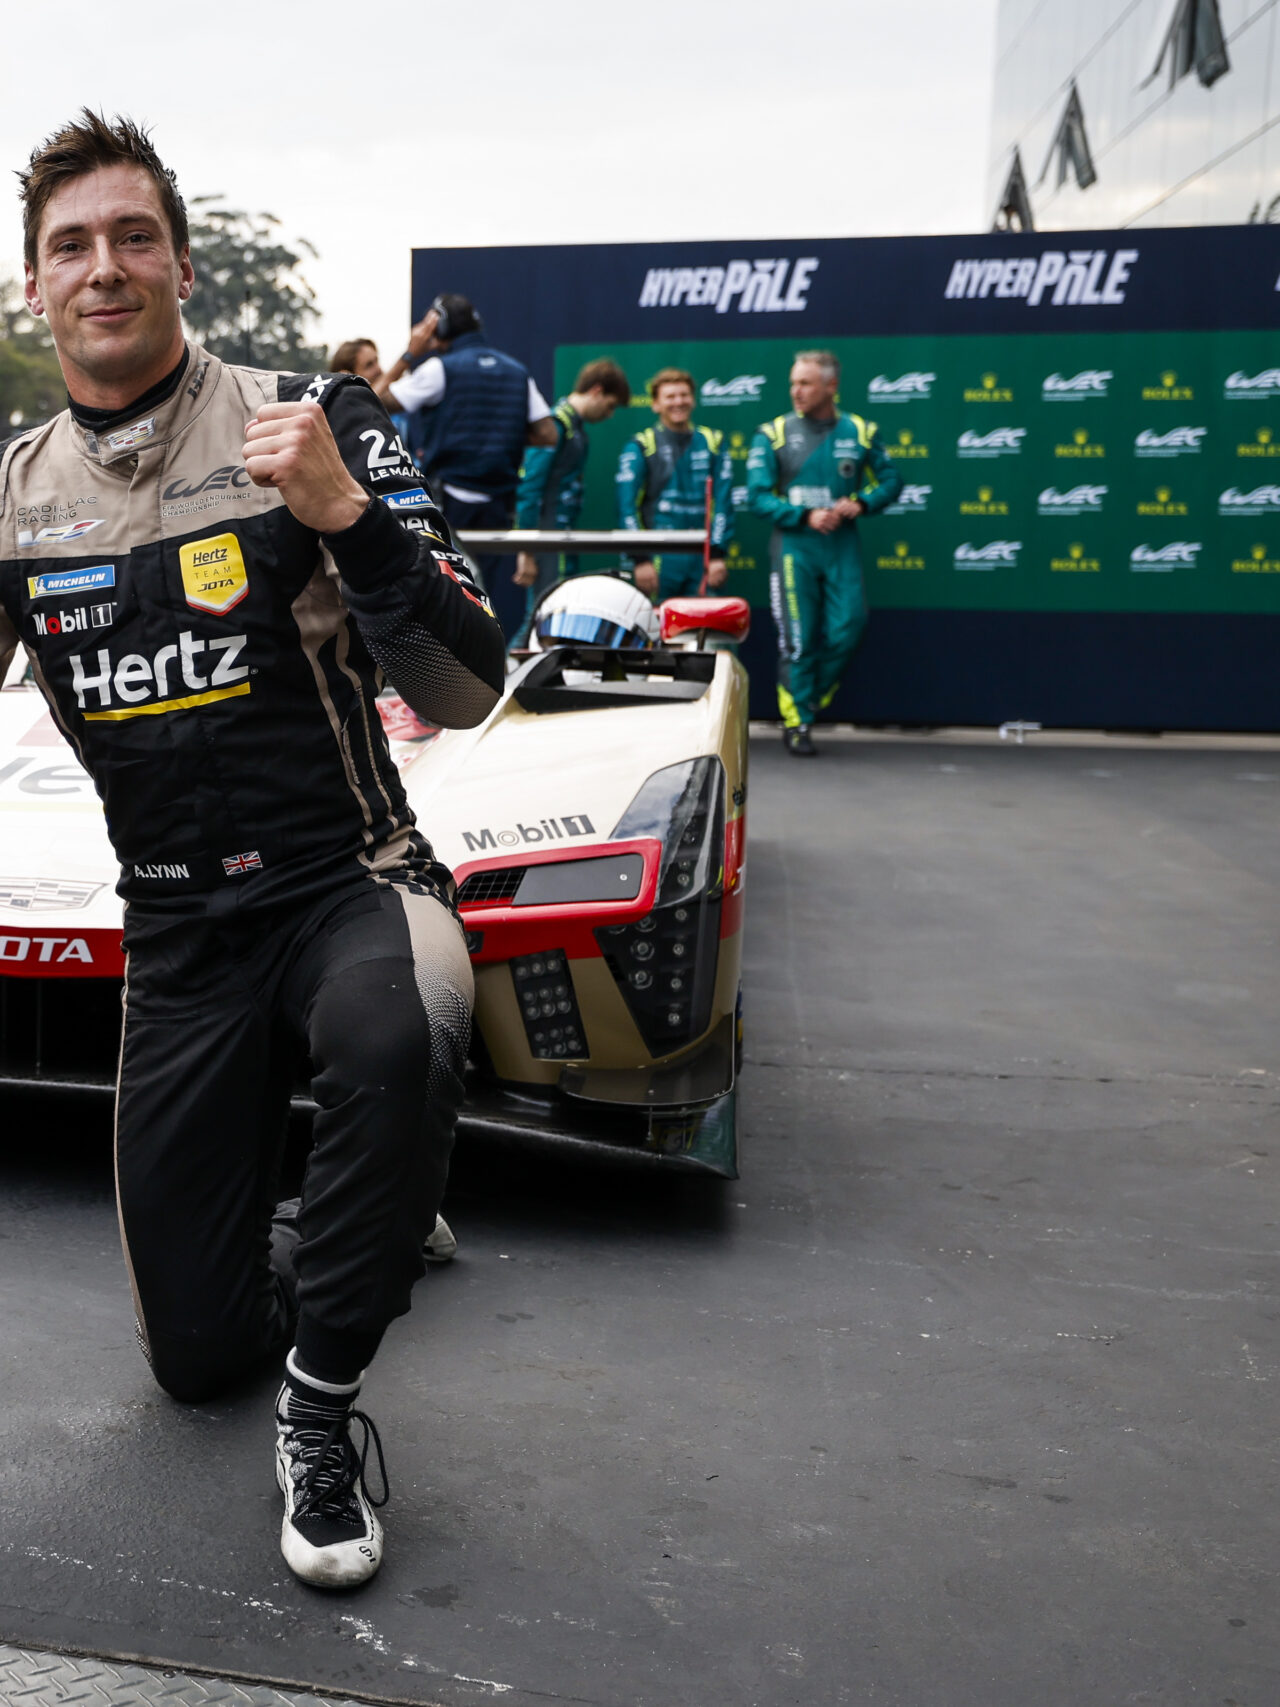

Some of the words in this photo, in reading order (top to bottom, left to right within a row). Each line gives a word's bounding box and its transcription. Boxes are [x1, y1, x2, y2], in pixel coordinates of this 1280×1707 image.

[369, 469, 390, 482] LE
[17, 496, 98, 516] CADILLAC
[17, 509, 77, 526] RACING
[193, 548, 228, 565] Hertz
[47, 572, 106, 589] MICHELIN
[194, 566, 232, 579] TEAM
[197, 578, 234, 592] JOTA
[32, 607, 88, 636] Mobil
[69, 630, 249, 709] Hertz
[462, 818, 564, 852] Mobil
[134, 863, 190, 879] A.LYNN
